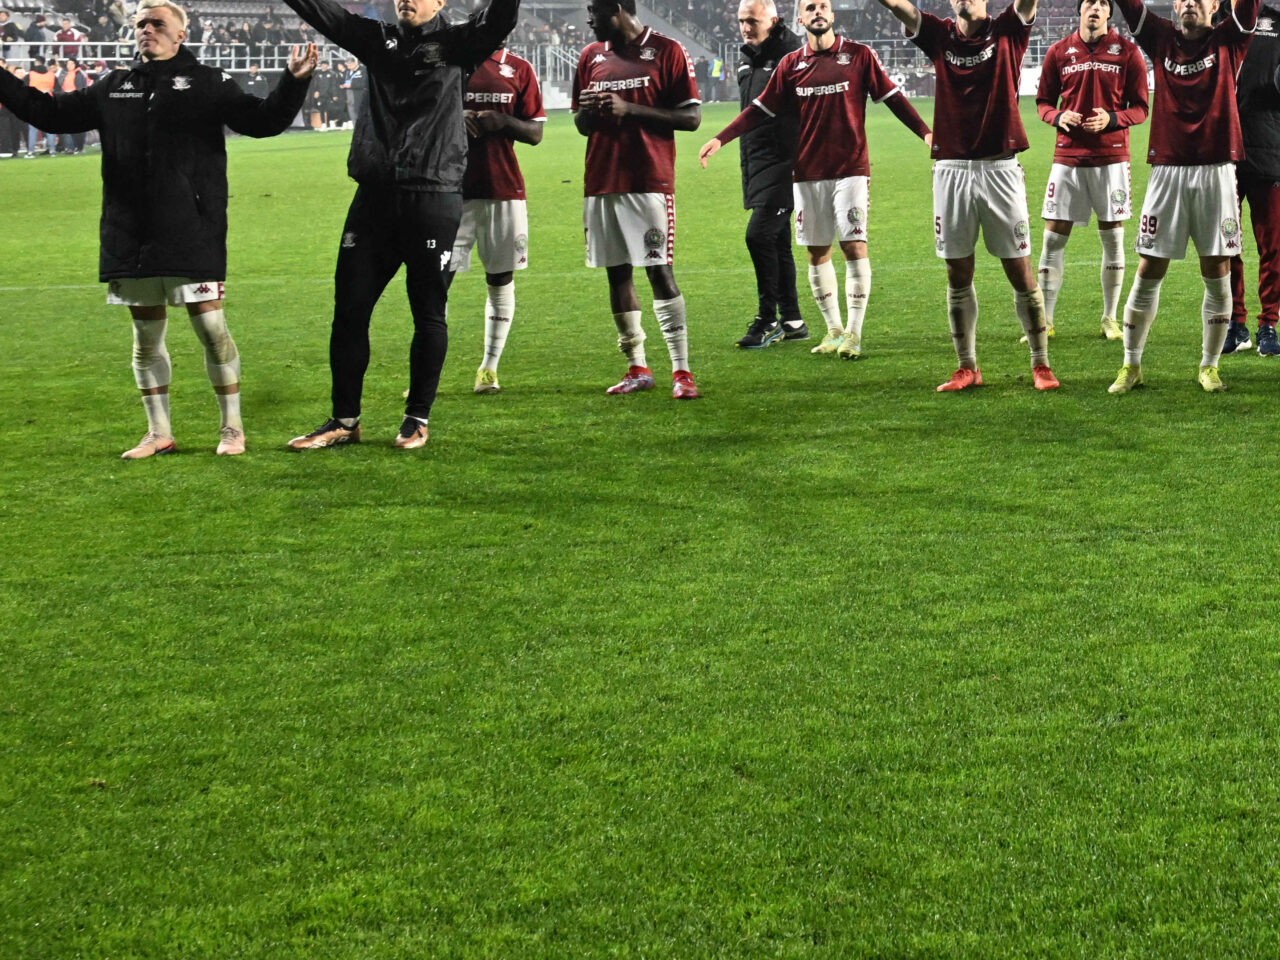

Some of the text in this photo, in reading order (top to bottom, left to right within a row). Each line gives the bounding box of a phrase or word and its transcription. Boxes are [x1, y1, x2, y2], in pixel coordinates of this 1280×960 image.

[1062, 61, 1122, 76] MOBEXPERT
[795, 80, 851, 97] SUPERBET
[1048, 182, 1055, 198] 9
[1141, 215, 1157, 235] 99
[426, 239, 437, 249] 13
